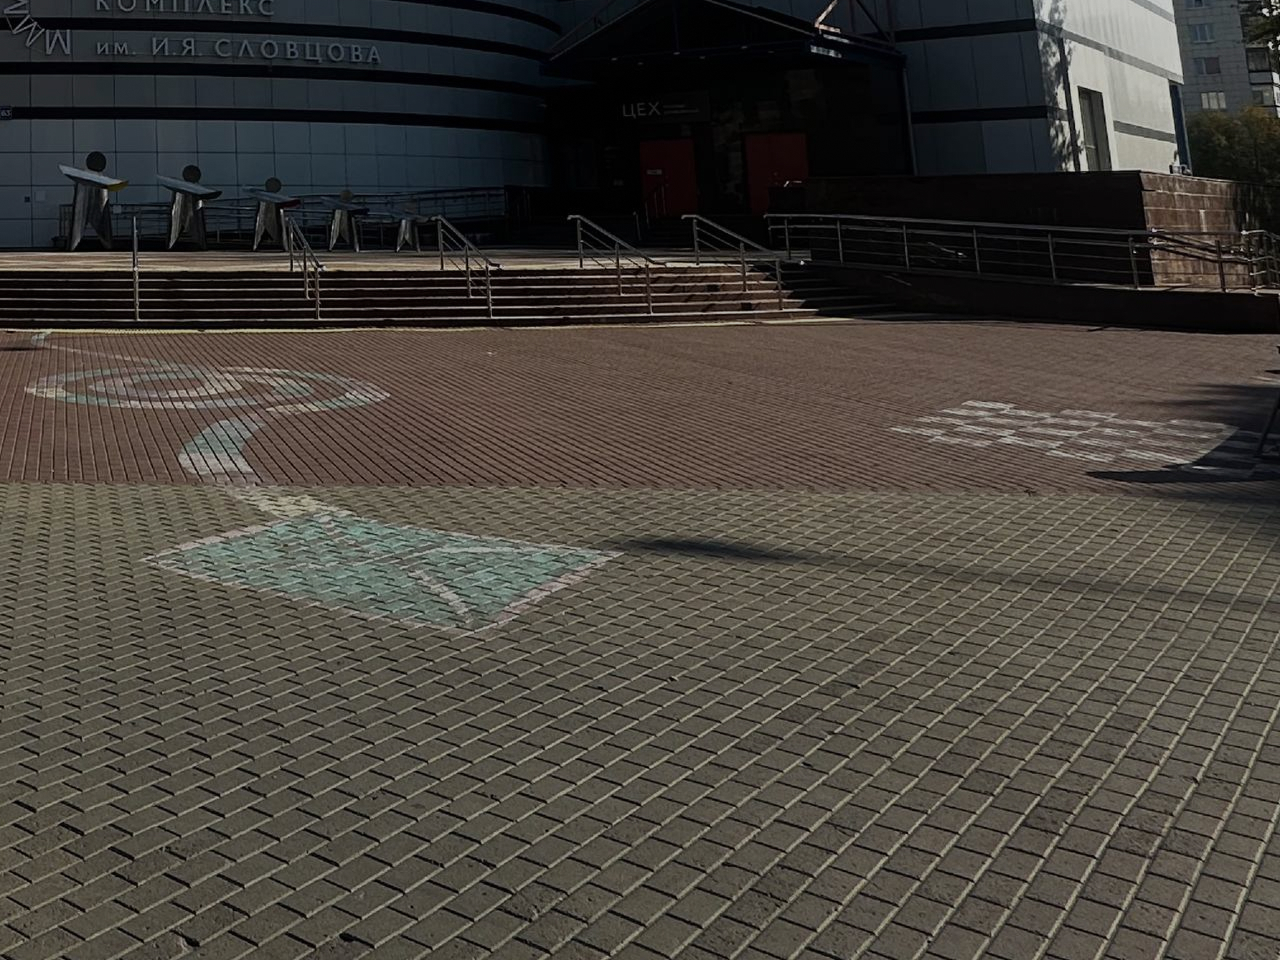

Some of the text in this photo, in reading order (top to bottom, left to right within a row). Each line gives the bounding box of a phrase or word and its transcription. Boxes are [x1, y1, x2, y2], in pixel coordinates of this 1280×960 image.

[96, 42, 137, 56] им.
[214, 38, 382, 64] СЛОВЦОВА
[622, 101, 662, 119] ЦЕХ
